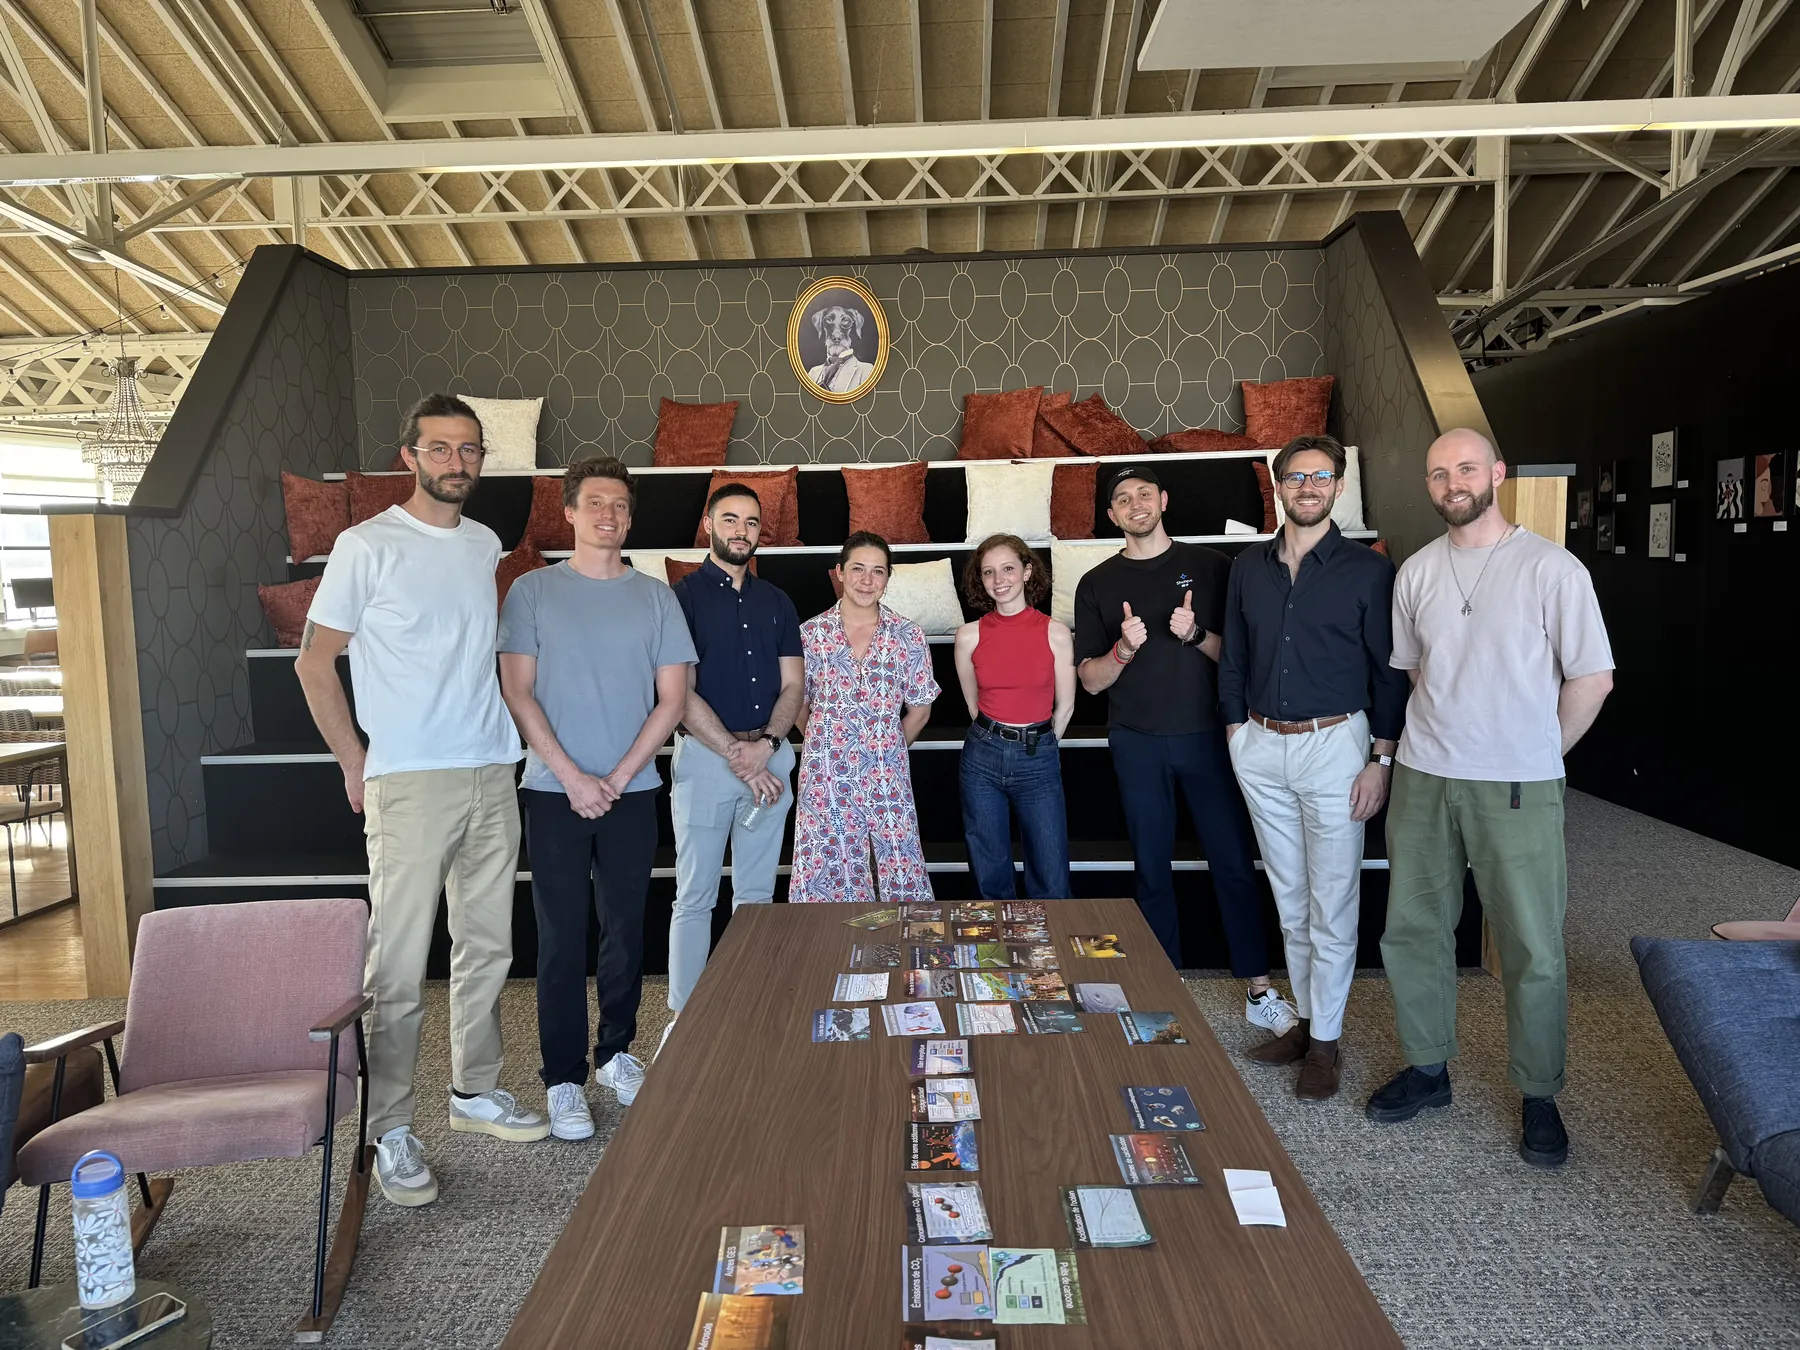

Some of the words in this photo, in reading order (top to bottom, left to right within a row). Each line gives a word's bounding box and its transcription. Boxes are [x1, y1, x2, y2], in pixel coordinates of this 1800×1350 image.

[1119, 1136, 1131, 1158] calcification
[910, 1159, 918, 1169] Effet
[911, 1185, 920, 1198] (ppm)
[1068, 1190, 1078, 1206] l'océan
[916, 1213, 926, 1243] Concentration
[1074, 1213, 1088, 1242] Acidification
[726, 1246, 736, 1258] GES
[725, 1259, 735, 1277] Autres
[1059, 1261, 1070, 1276] Puits
[1062, 1276, 1071, 1284] de
[911, 1279, 921, 1308] Émissions
[1063, 1285, 1074, 1309] carbone
[699, 1323, 713, 1350] Aérosols
